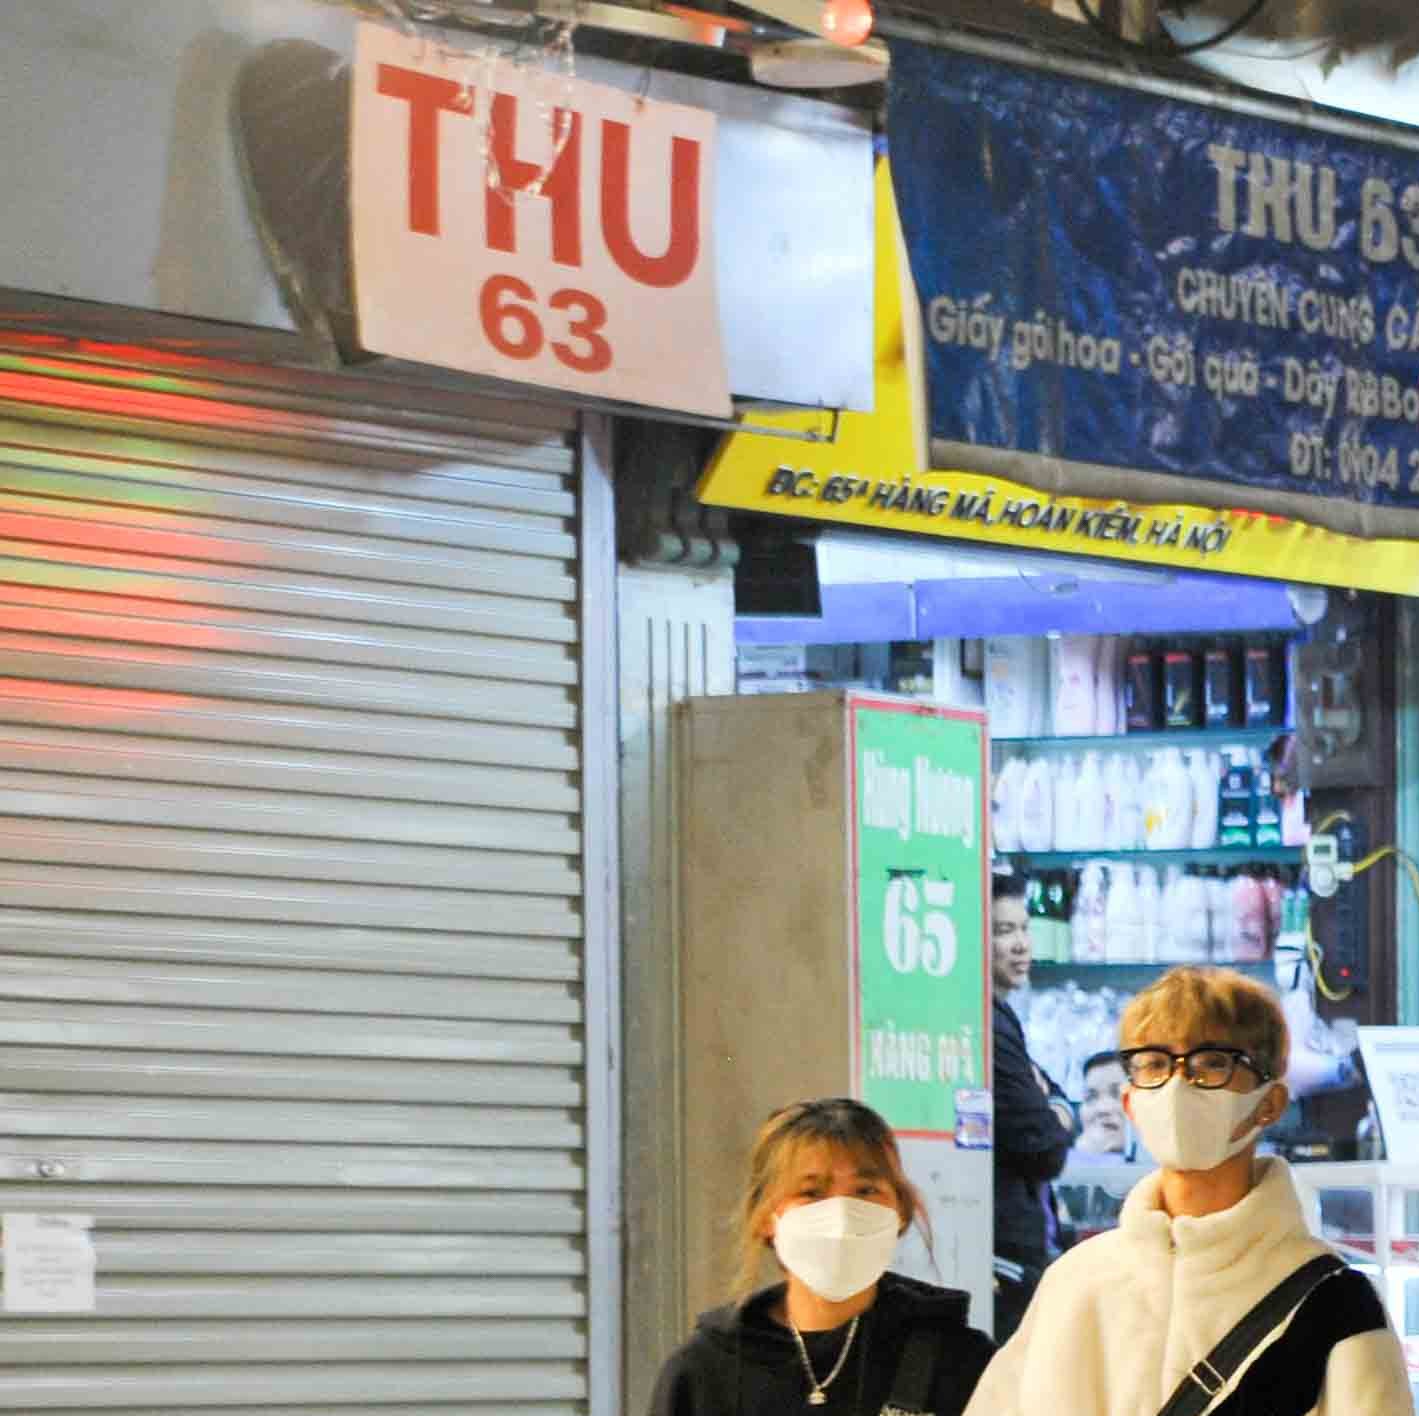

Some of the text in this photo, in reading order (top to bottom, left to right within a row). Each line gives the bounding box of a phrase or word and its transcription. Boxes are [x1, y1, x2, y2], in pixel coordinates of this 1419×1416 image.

[377, 63, 701, 289] THU
[1207, 145, 1338, 251] THU
[479, 274, 613, 372] 63
[1057, 319, 1121, 376] hoa
[882, 875, 958, 977] 65
